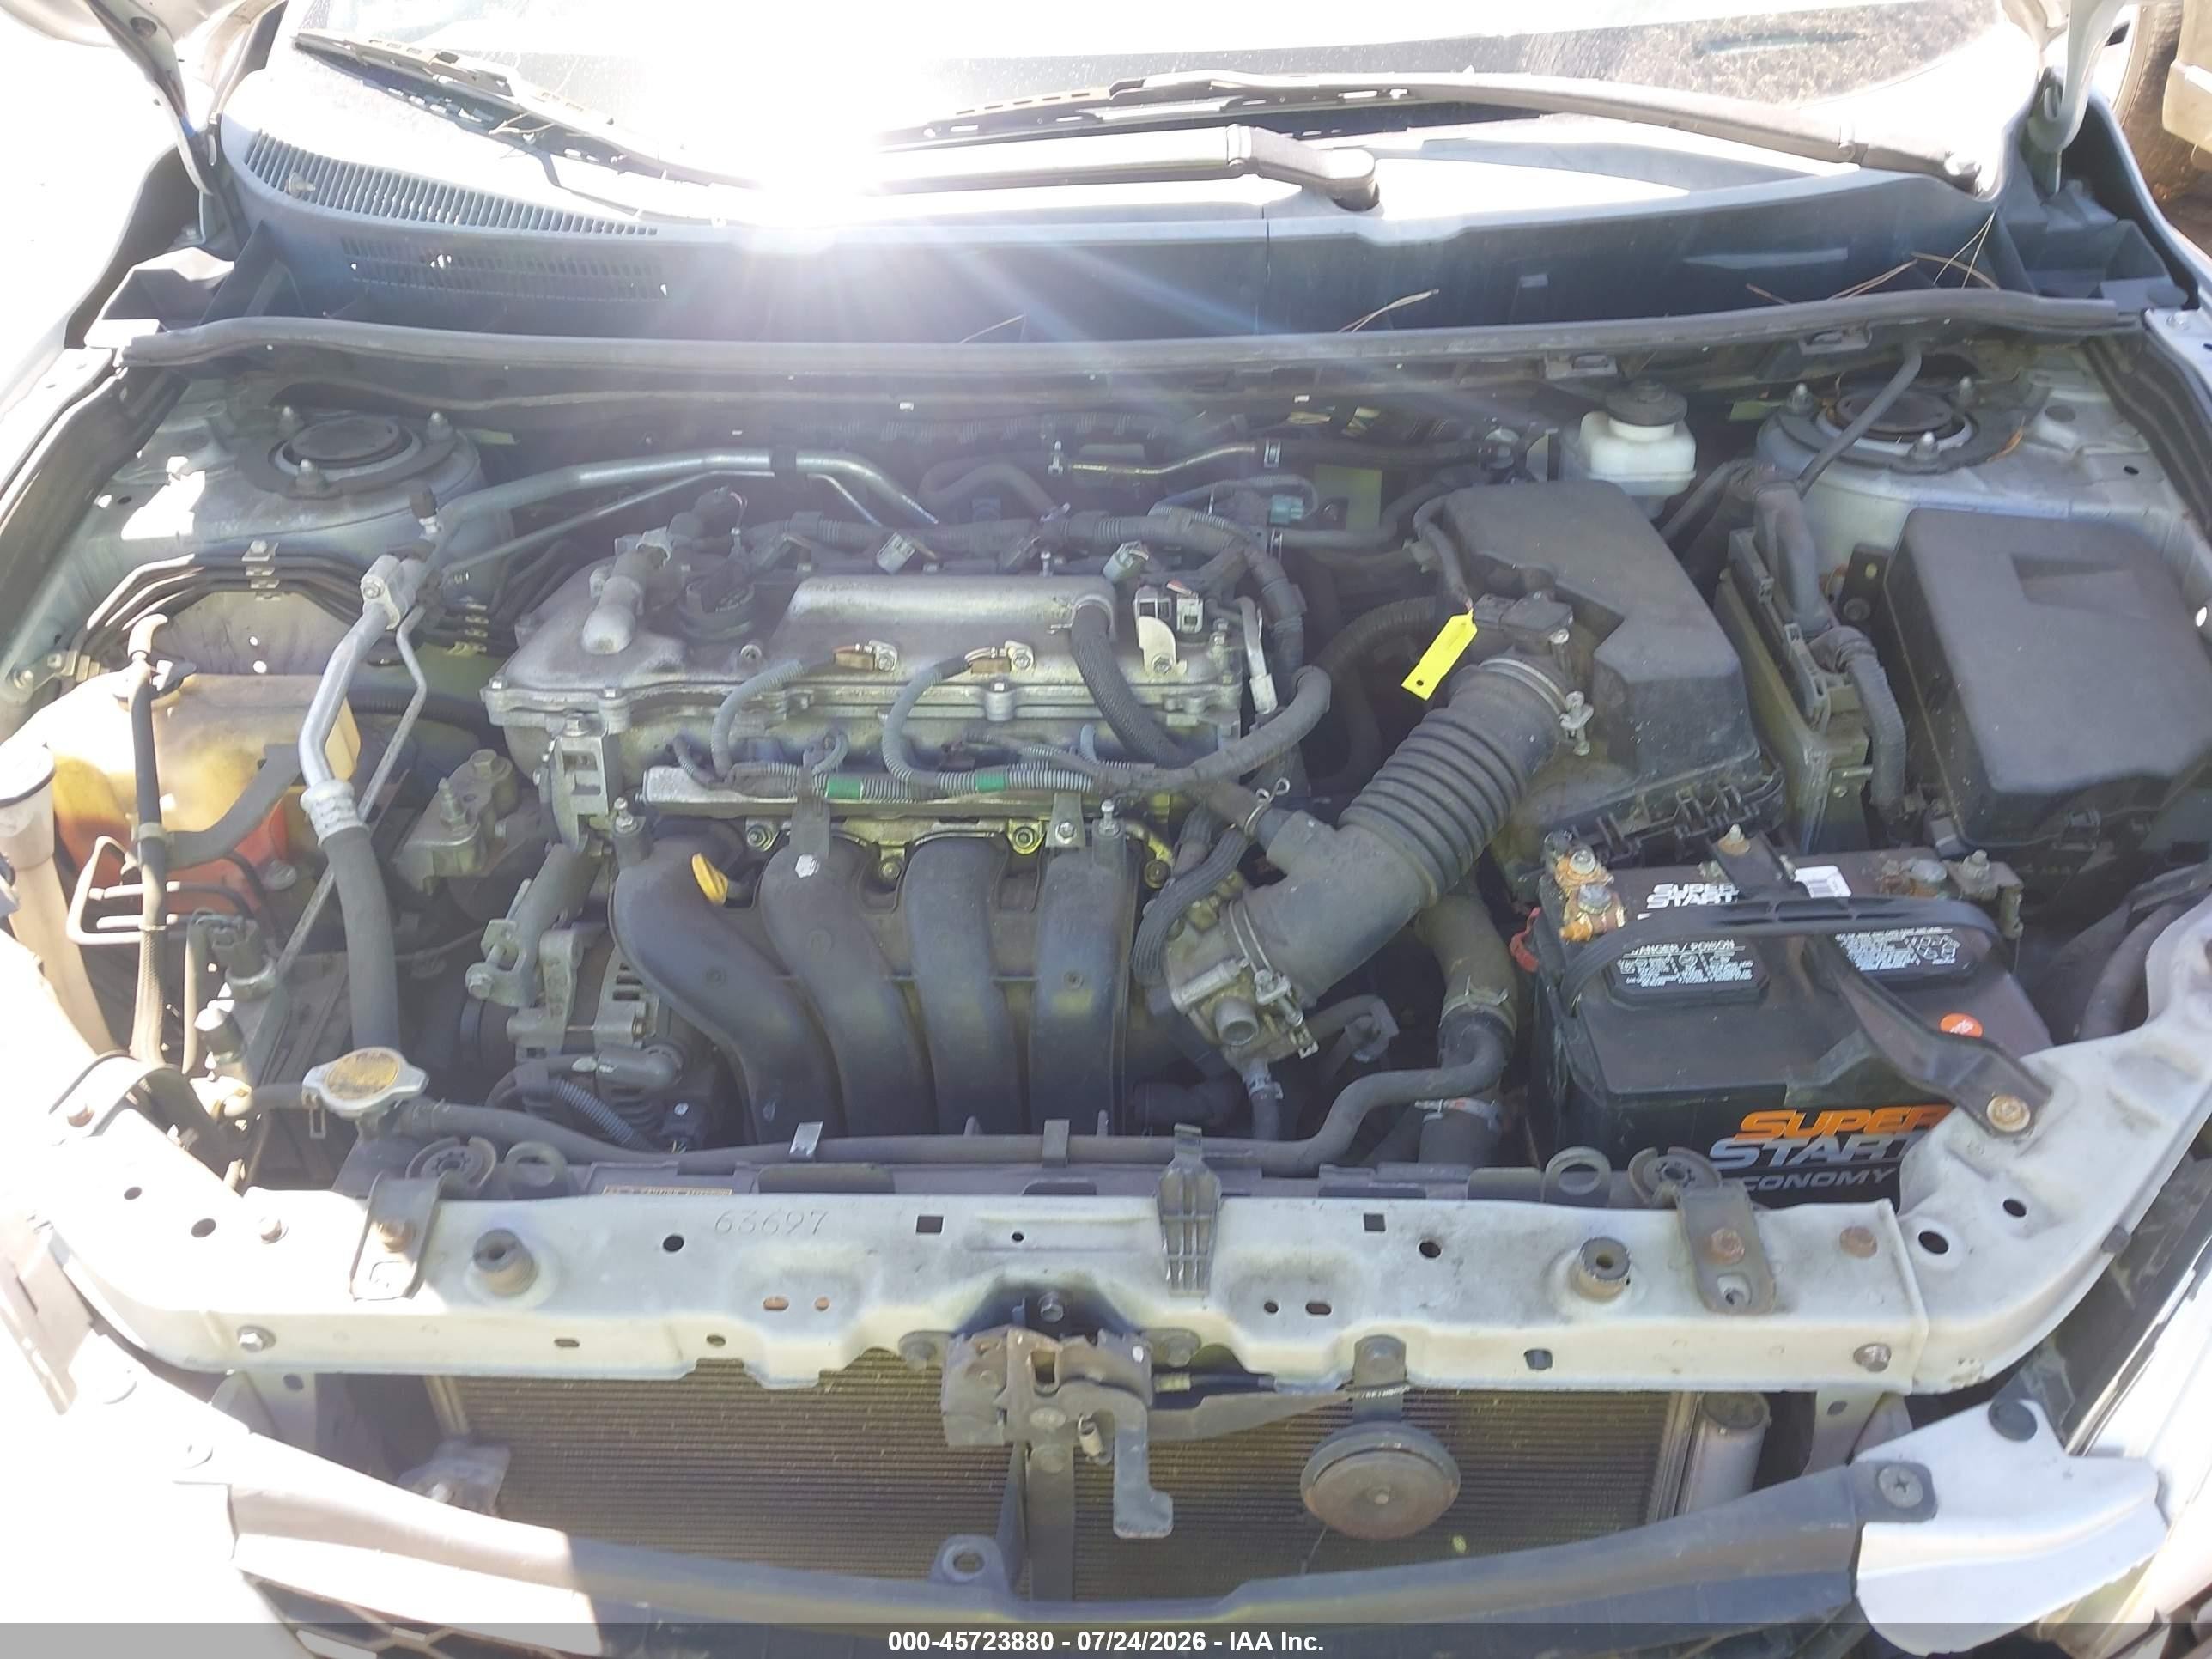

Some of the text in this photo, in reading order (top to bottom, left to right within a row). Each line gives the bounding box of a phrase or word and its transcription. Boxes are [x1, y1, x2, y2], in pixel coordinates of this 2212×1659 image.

[1647, 893, 1737, 909] START
[1653, 883, 1739, 896] SUPER
[1735, 1105, 1954, 1140] SUPER
[1710, 1133, 1929, 1170] START
